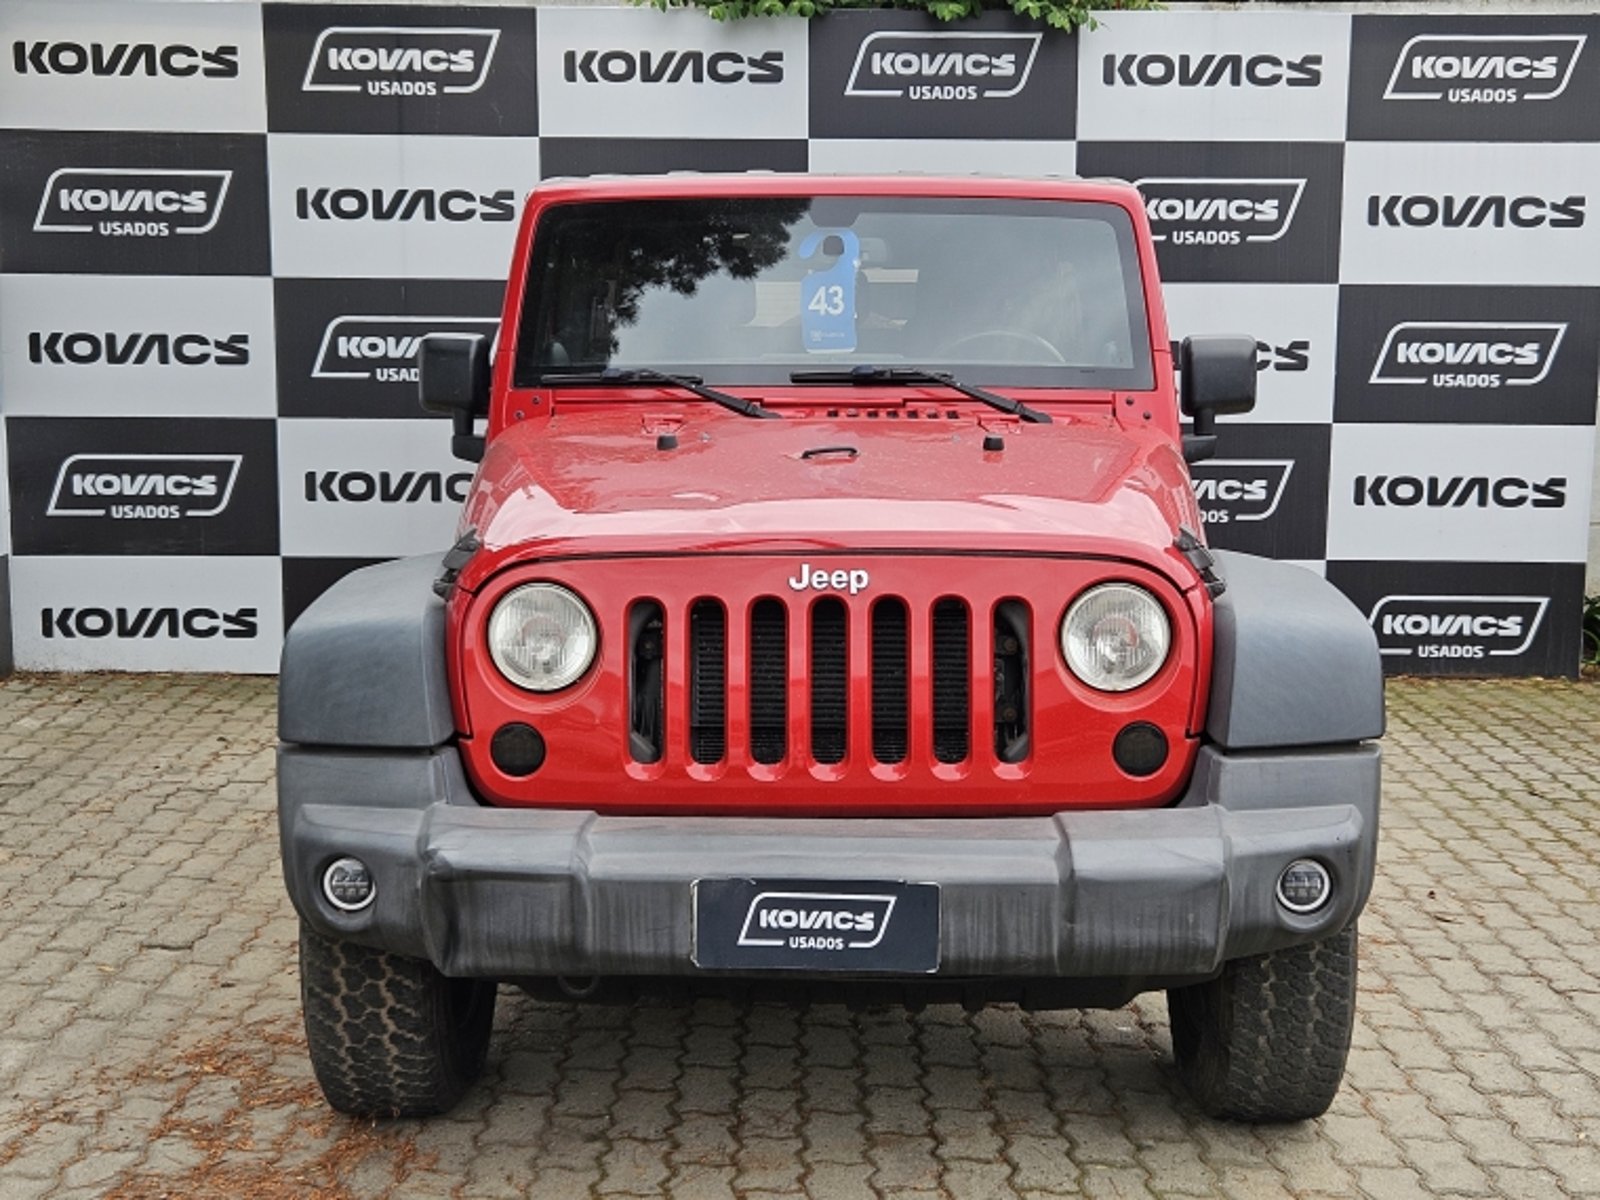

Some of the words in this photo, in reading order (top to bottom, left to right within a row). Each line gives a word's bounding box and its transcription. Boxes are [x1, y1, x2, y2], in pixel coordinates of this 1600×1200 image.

[13, 41, 239, 78] KOVACS
[328, 47, 475, 73] KOVACS
[563, 50, 784, 84] KOVACS
[871, 52, 1016, 77] KOVACS
[1102, 54, 1323, 87] KOVACS
[1411, 55, 1558, 79] KOVACS
[367, 80, 437, 96] USADOS
[909, 85, 978, 100] USADOS
[1448, 88, 1517, 103] USADOS
[59, 188, 207, 213] KOVACS
[296, 187, 515, 222] KOVACS
[1367, 195, 1586, 228] KOVACS
[99, 221, 169, 237] USADOS
[1172, 230, 1241, 245] USADOS
[807, 285, 845, 316] 43
[28, 331, 250, 366] KOVACS
[1397, 342, 1540, 365] KOVACS
[375, 367, 420, 381] USAD
[1432, 373, 1501, 388] USADOS
[72, 473, 218, 497] KOVACS
[305, 471, 474, 503] KOVAC
[1353, 475, 1567, 508] KOVACS
[110, 504, 181, 519] USADOS
[789, 563, 869, 594] Jeep
[41, 607, 258, 639] KOVACS
[1382, 614, 1523, 637] KOVACS
[1417, 644, 1484, 659] USADOS
[759, 908, 875, 931] KOVACS
[789, 936, 844, 950] USADOS
